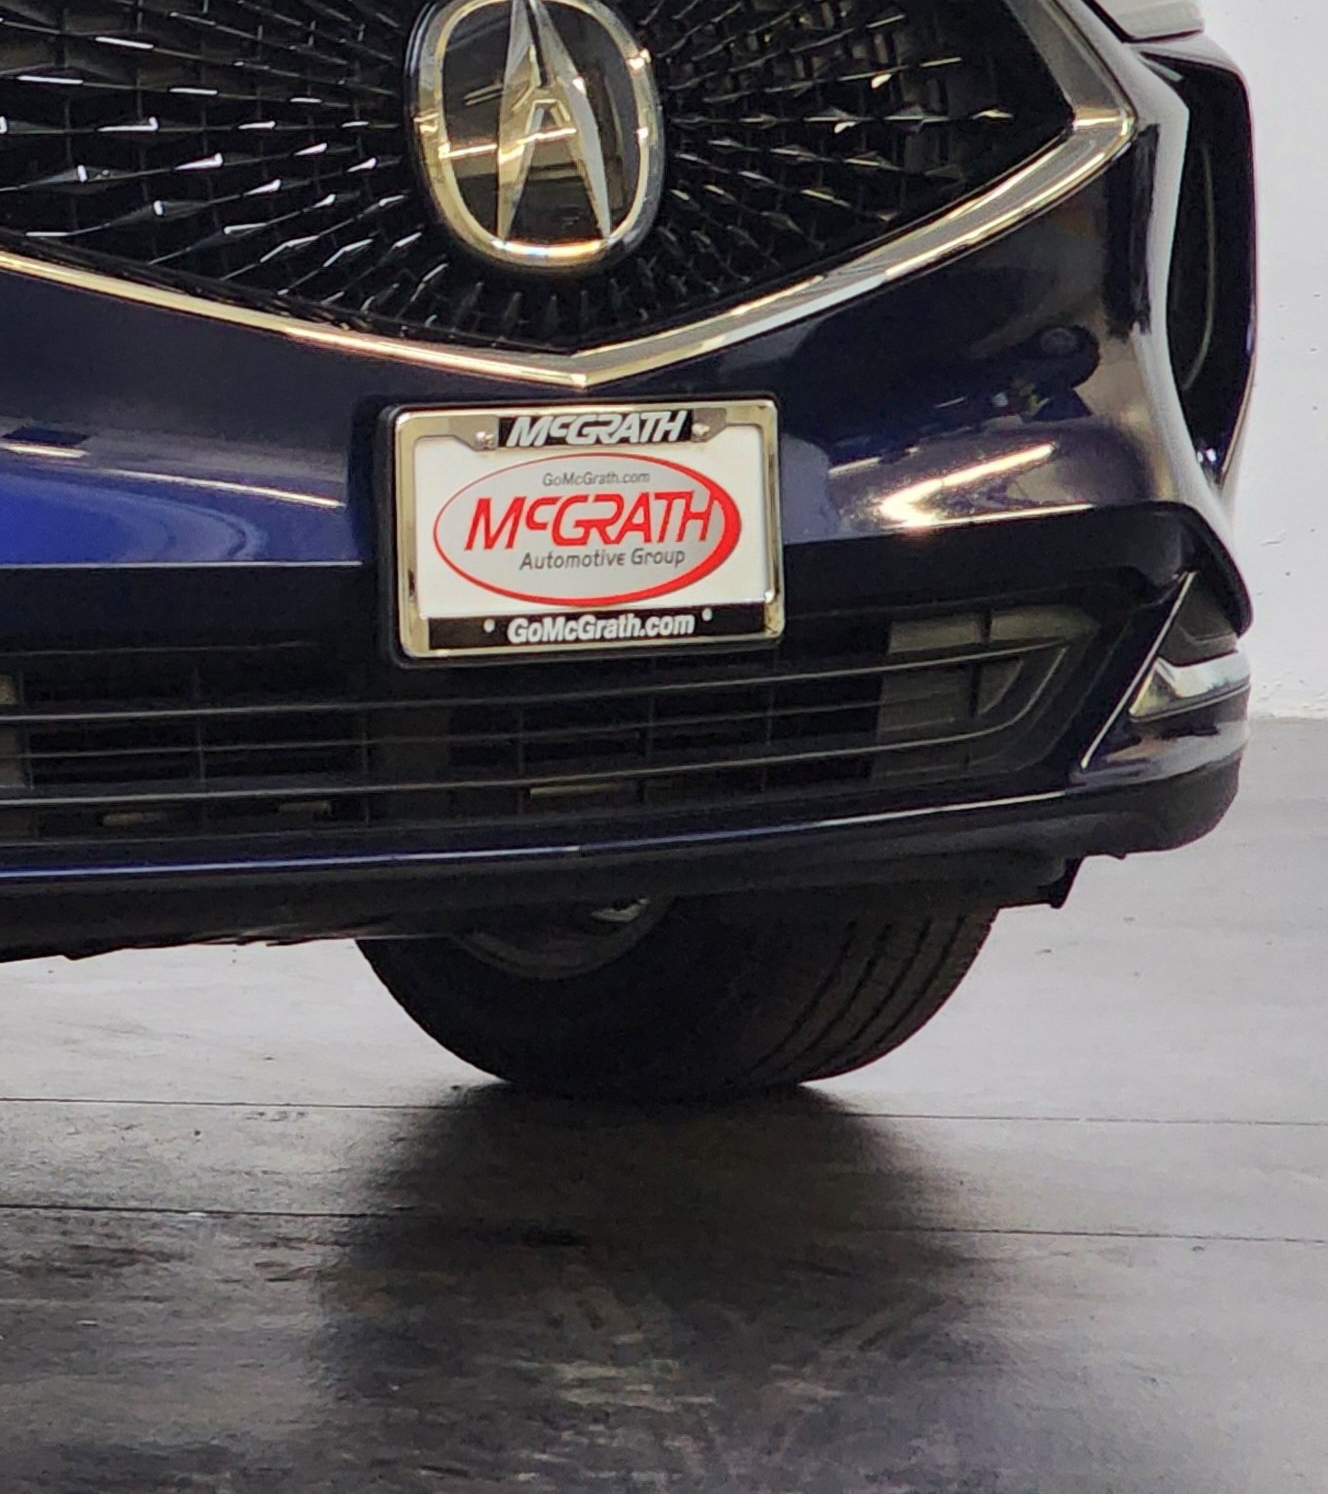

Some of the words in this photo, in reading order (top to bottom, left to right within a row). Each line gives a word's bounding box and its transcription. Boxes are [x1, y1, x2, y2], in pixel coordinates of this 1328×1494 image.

[542, 470, 651, 488] GoMcGrath.com
[518, 549, 626, 571] Automotive
[631, 548, 686, 569] Group
[506, 613, 696, 644] GoMcGrath.com
